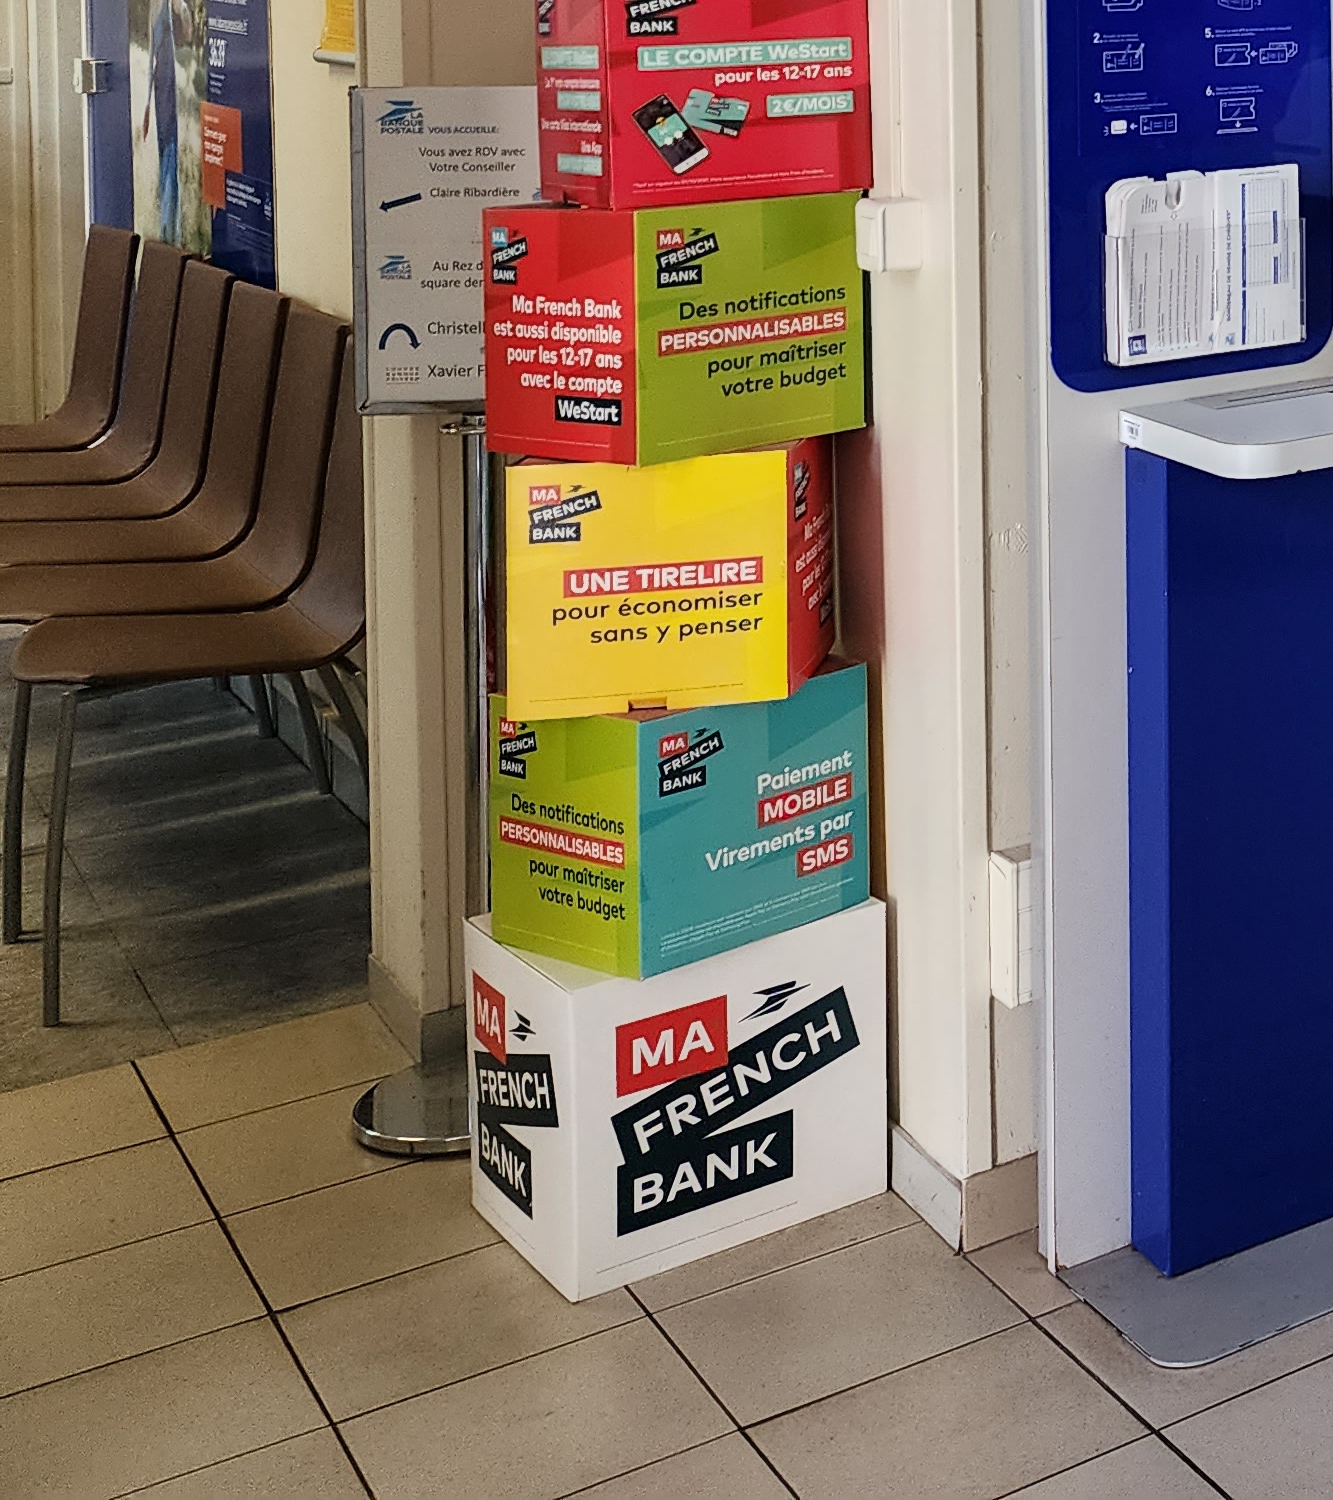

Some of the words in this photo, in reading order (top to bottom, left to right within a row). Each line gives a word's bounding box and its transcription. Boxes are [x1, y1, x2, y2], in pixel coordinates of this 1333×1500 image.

[642, 50, 669, 67] LE
[674, 45, 764, 65] COMPTE
[766, 41, 848, 60] WeStart
[714, 71, 754, 87] pour
[756, 67, 780, 82] les
[782, 64, 821, 81] 12-17
[823, 65, 853, 78] ans
[418, 146, 446, 158] Vous
[448, 148, 473, 158] avez
[474, 146, 500, 158] RDV
[500, 148, 527, 158] avec
[428, 162, 460, 173] Votre
[461, 161, 516, 173] Conseiller
[429, 187, 461, 198] Claire
[463, 186, 521, 198] Ribardière
[512, 295, 533, 315] Ma
[535, 297, 582, 318] French
[584, 299, 622, 320] Bank
[679, 299, 719, 321] Des
[724, 284, 847, 316] notifications
[660, 312, 846, 352] PERSONNALISABLES
[707, 355, 755, 379] pour
[759, 339, 847, 368] maîtriser
[721, 372, 774, 398] votre
[780, 362, 847, 393] budget
[558, 399, 619, 422] WeStart
[569, 571, 630, 595] UNE
[635, 560, 758, 589] TIRELIRE
[551, 604, 610, 627] pour
[617, 590, 764, 618] économiser
[590, 623, 648, 644] sans
[655, 624, 671, 645] y
[678, 614, 764, 642] penser
[757, 750, 853, 795] Paiement
[763, 778, 849, 823] MOBILE
[705, 823, 815, 872] Virements
[820, 810, 855, 839] par
[801, 838, 850, 873] SMS
[631, 1019, 715, 1076] MA
[632, 1008, 844, 1155] FRENCH
[633, 1131, 778, 1215] BANK
